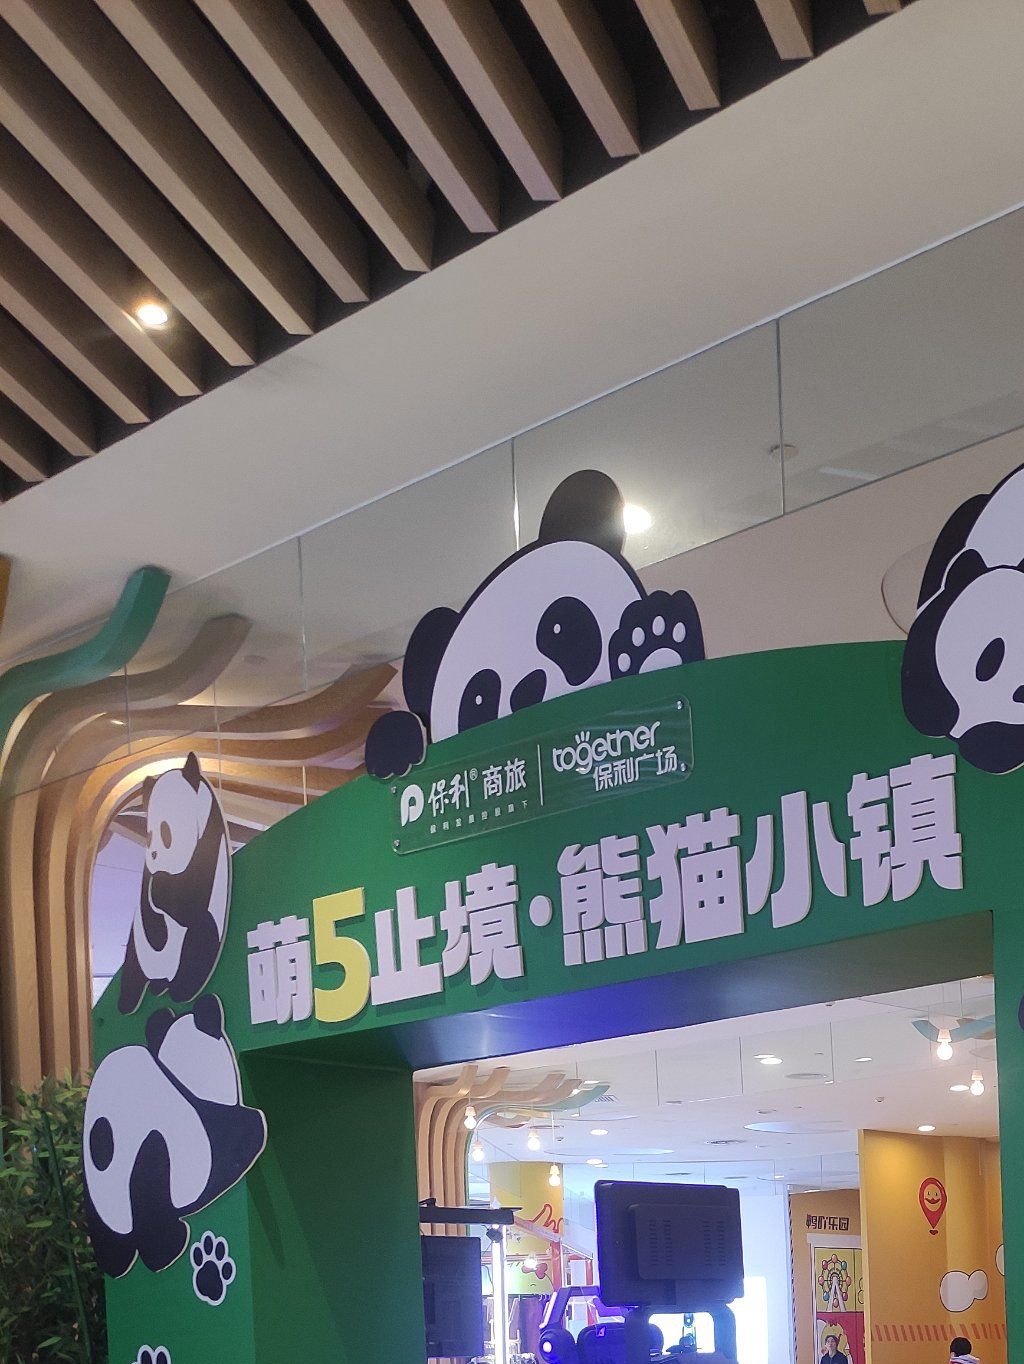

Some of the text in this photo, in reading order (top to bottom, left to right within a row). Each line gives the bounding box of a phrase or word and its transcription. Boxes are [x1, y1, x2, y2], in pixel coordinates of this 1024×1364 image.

[552, 720, 661, 775] together
[593, 745, 678, 792] 保利广场
